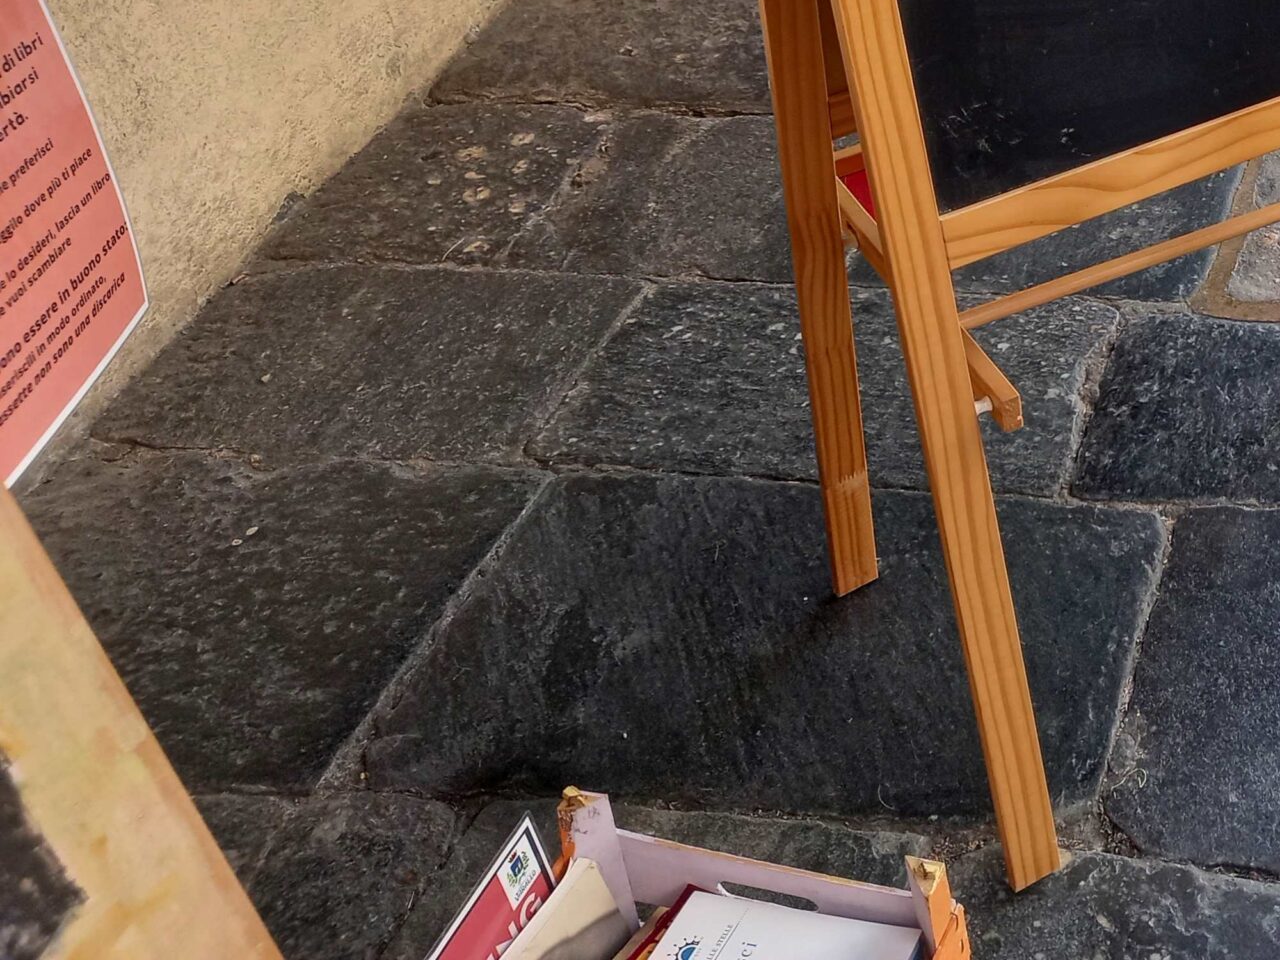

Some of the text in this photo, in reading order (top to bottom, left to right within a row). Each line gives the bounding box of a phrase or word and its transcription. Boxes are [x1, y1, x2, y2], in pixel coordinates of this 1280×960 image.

[0, 66, 39, 109] biarsi
[2, 32, 44, 73] di libri
[0, 148, 92, 245] ggilo dove più ti piace
[9, 138, 54, 187] preferisci
[5, 270, 17, 282] lo
[17, 229, 56, 271] desideri,
[55, 202, 80, 233] lascia
[80, 191, 92, 207] un
[91, 172, 111, 196] libro
[5, 281, 27, 307] vuoi
[27, 236, 72, 287] scambiare
[0, 342, 22, 368] ono
[23, 301, 58, 344] essere
[58, 289, 70, 305] in
[70, 253, 101, 292] buono
[0, 275, 107, 399] seriscili in modo ordinato,
[34, 361, 51, 385] non
[52, 334, 73, 364] sono
[74, 316, 91, 338] una
[92, 272, 125, 318] discarica
